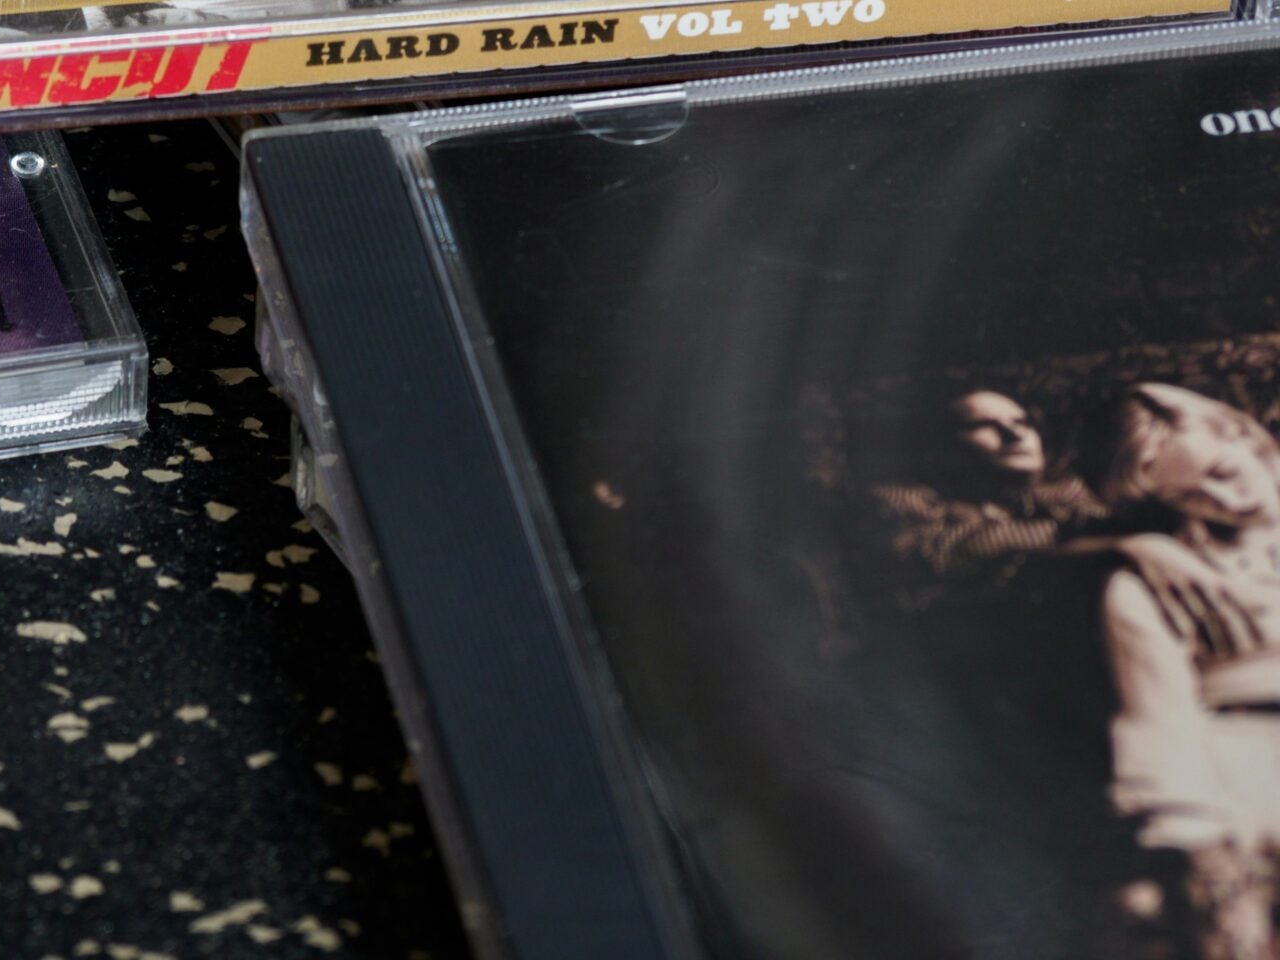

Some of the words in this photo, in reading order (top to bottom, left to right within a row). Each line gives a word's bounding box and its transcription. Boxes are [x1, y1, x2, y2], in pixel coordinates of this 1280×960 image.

[305, 35, 458, 67] HARD
[481, 18, 619, 54] RAIN
[640, 9, 743, 40] VOL
